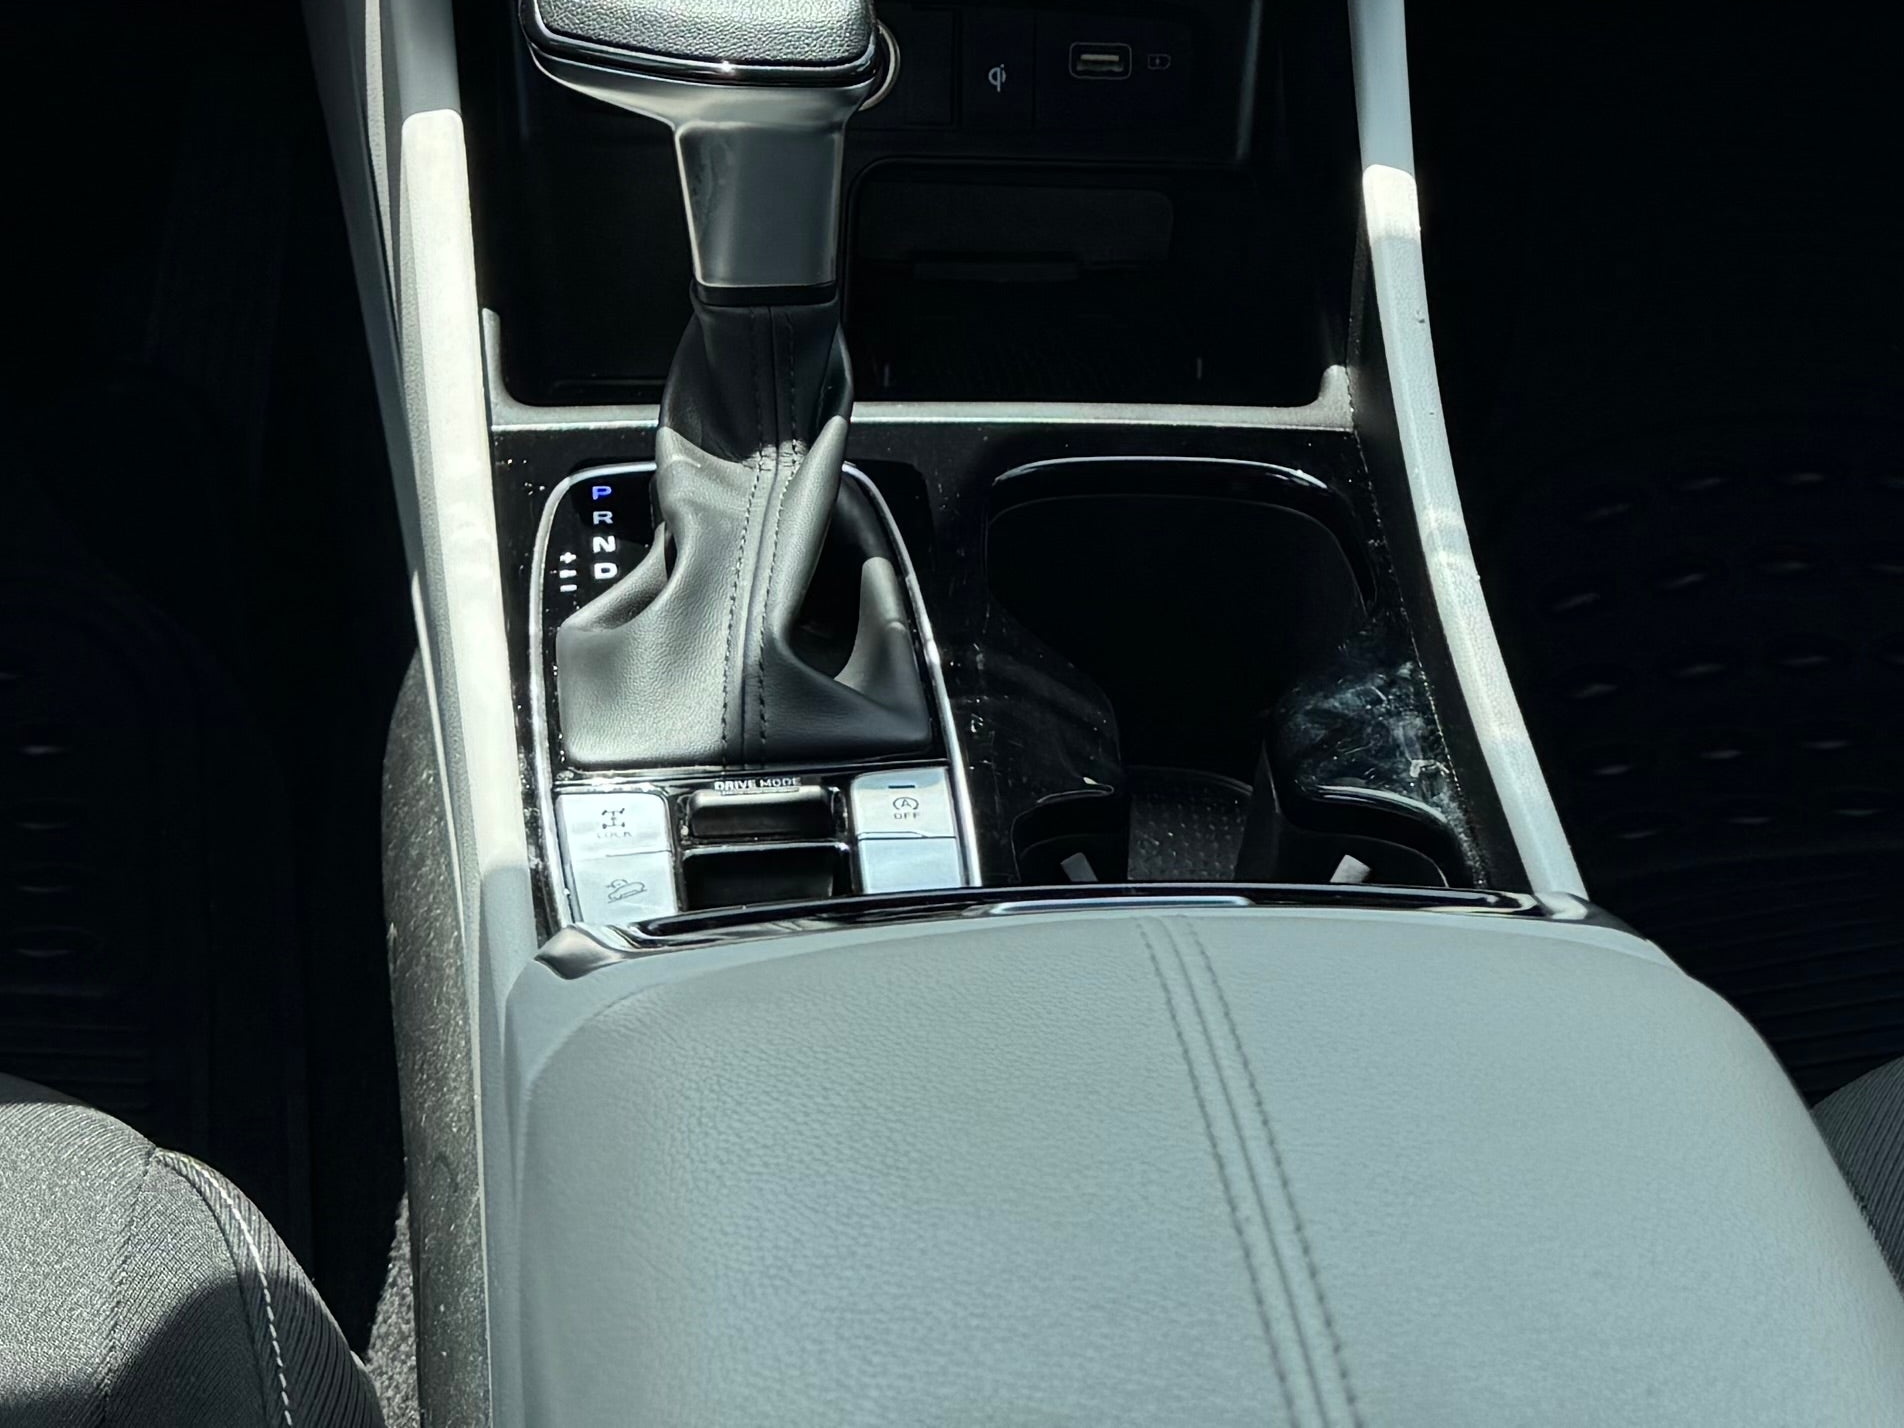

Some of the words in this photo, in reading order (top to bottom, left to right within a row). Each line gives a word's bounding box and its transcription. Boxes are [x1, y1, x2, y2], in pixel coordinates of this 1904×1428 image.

[592, 486, 612, 500] P
[593, 511, 613, 525] R
[593, 535, 615, 553] N
[594, 562, 617, 579] D
[715, 778, 756, 791] DRIVE
[759, 776, 801, 788] MODE
[893, 812, 920, 821] OFF
